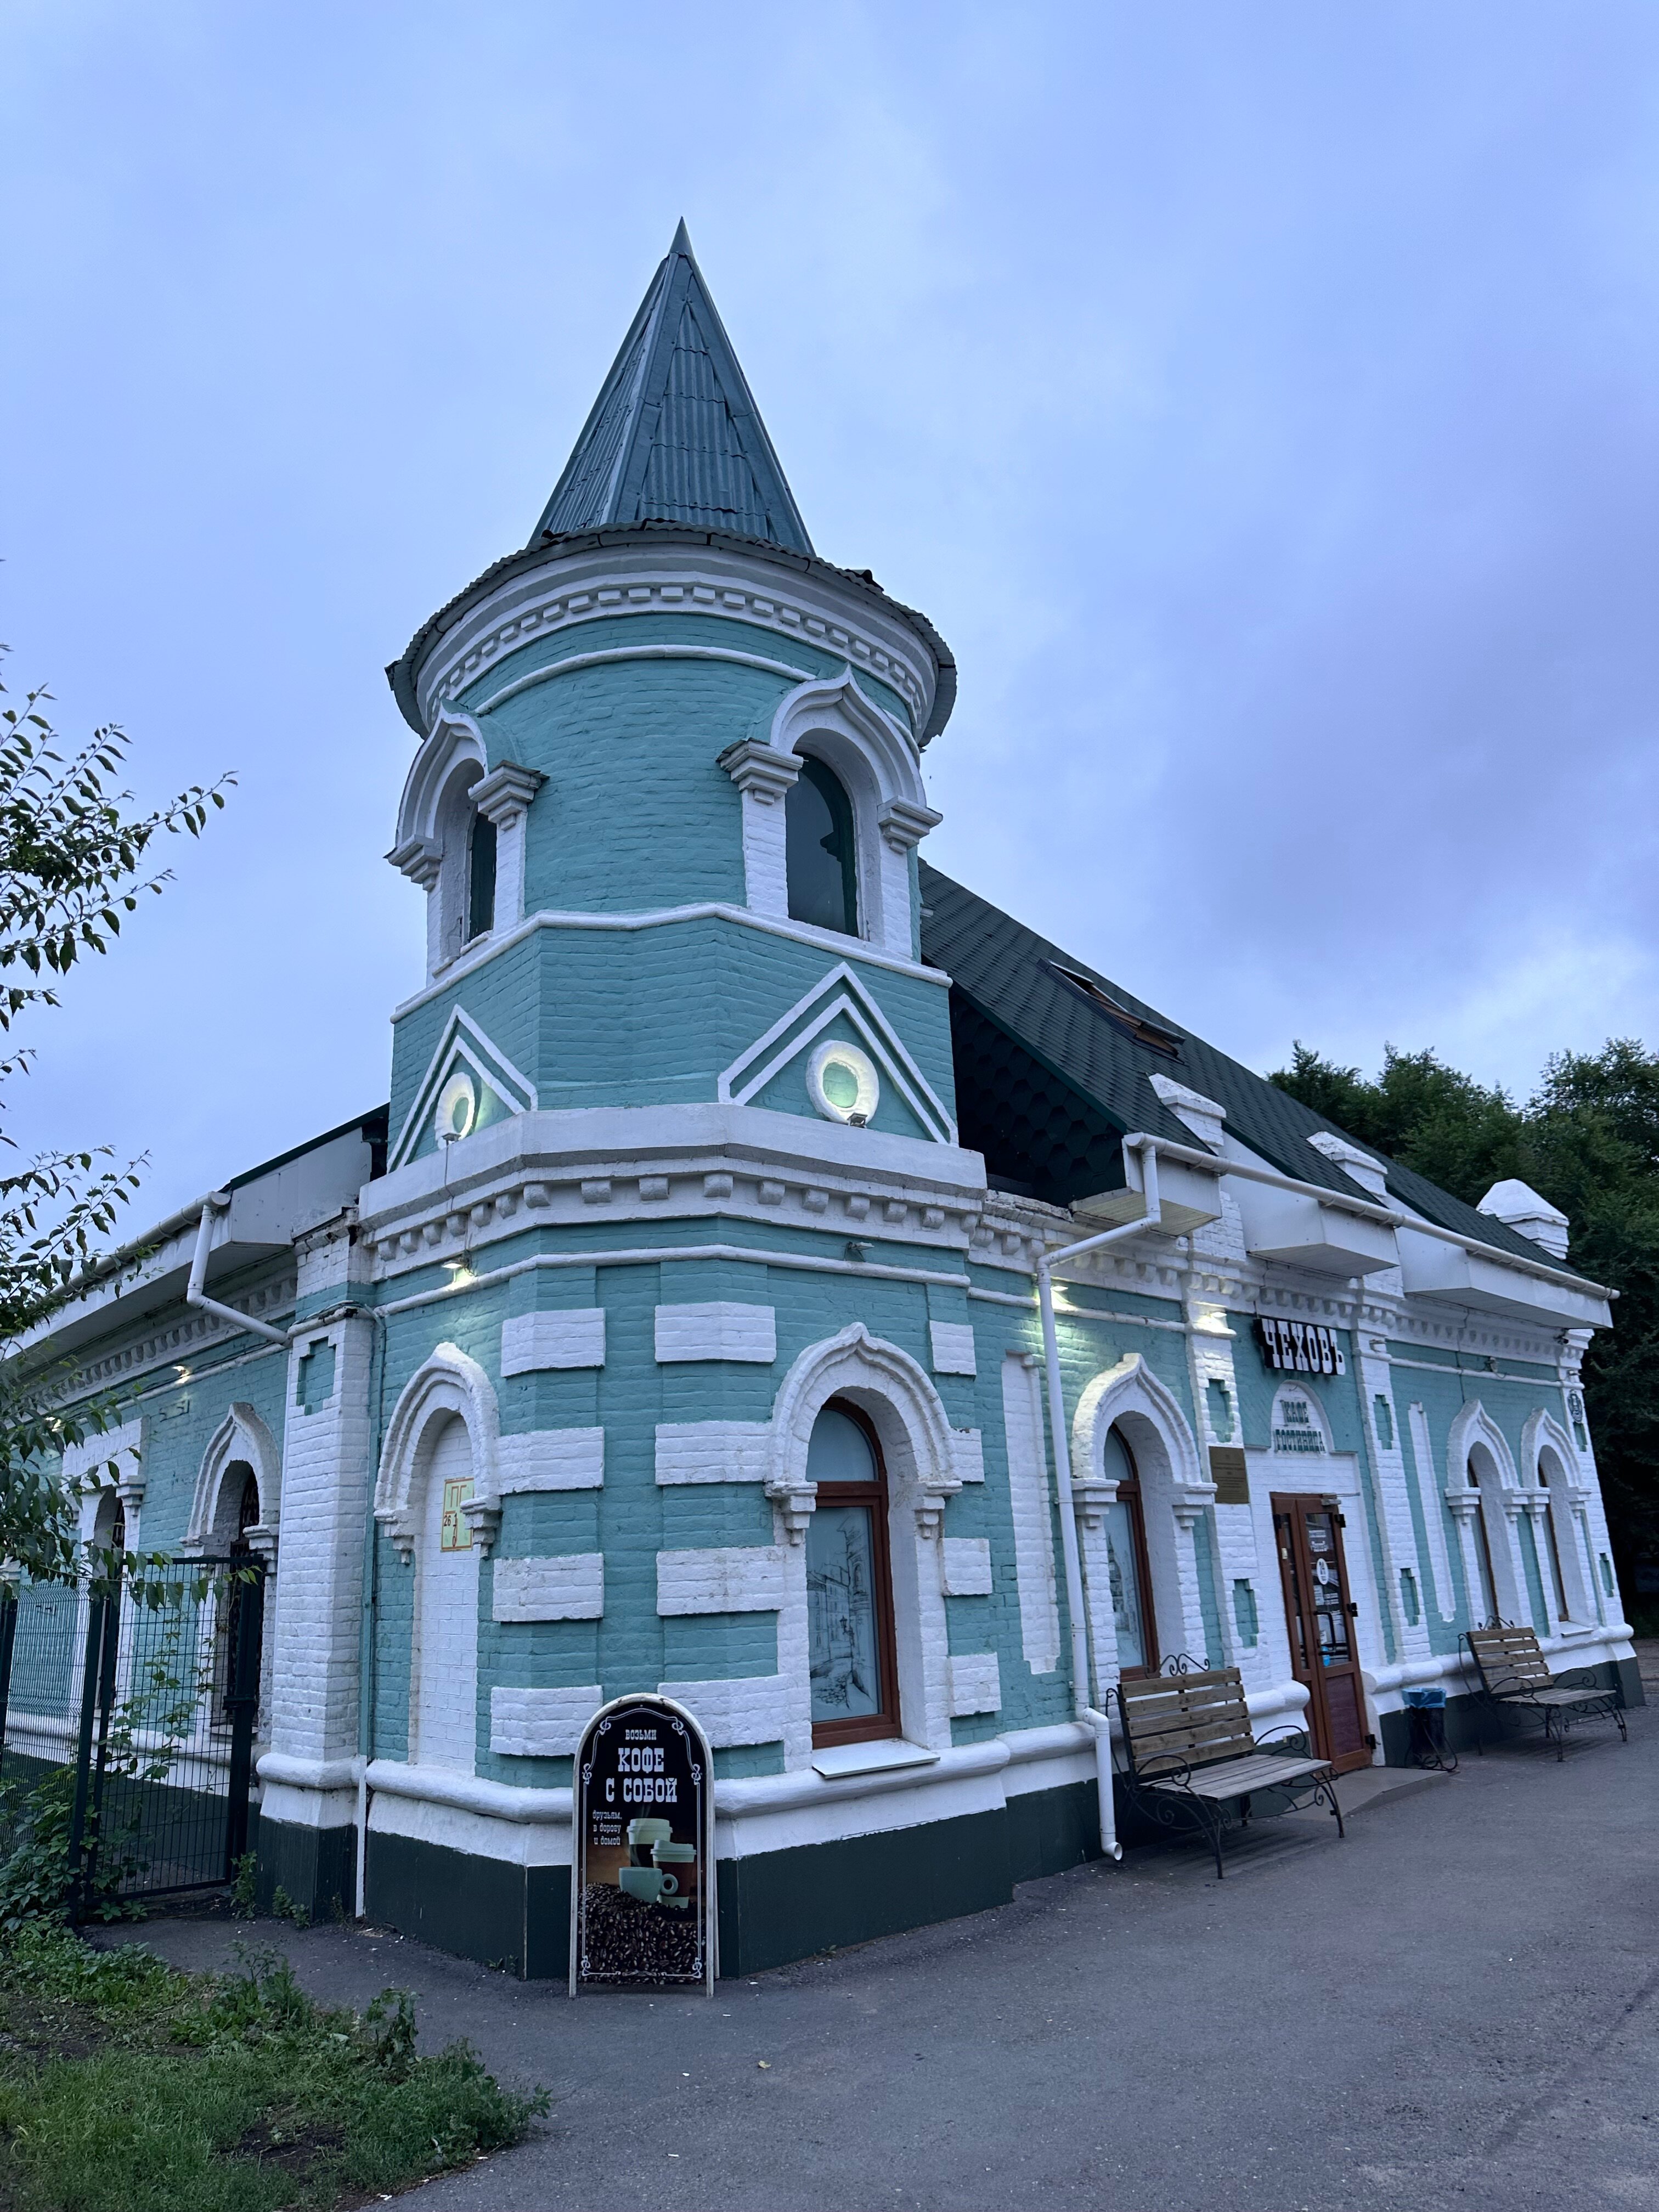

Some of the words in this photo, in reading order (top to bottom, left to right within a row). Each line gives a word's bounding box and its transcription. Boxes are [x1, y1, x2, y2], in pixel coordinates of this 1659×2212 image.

[1262, 1318, 1346, 1375] ЧЕХОВЪ
[1283, 1401, 1310, 1423] КАФЕ
[1275, 1429, 1326, 1453] ГОСТИНИЦА
[443, 1515, 451, 1527] 26
[618, 1746, 664, 1774] КОФЕ
[606, 1778, 615, 1803] С
[623, 1778, 678, 1803] СОБОЙ
[600, 1822, 622, 1834] дорогу
[594, 1837, 599, 1845] и
[600, 1835, 621, 1846] домой
